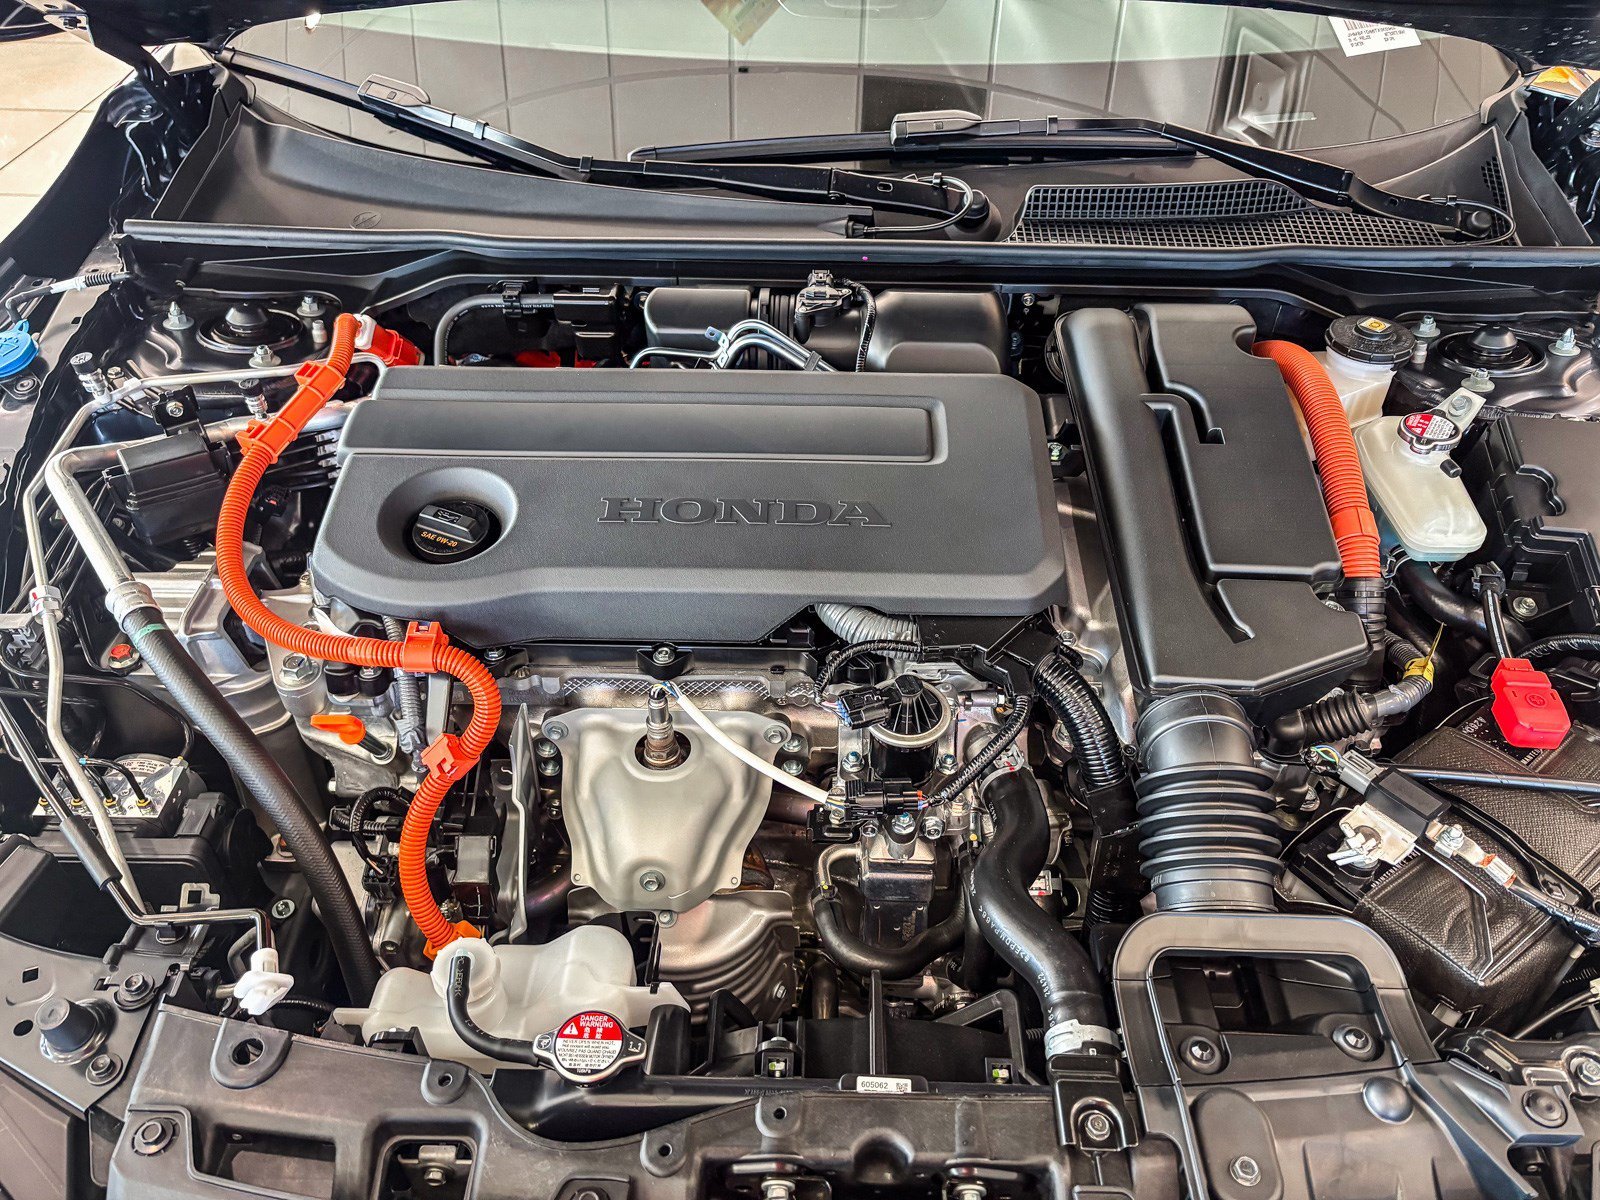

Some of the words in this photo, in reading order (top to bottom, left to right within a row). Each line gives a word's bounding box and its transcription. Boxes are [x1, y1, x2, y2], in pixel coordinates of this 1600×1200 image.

[597, 497, 892, 528] HONDA
[420, 531, 436, 541] SAE
[436, 536, 458, 547] 0W-20
[861, 1080, 889, 1090] 605062
